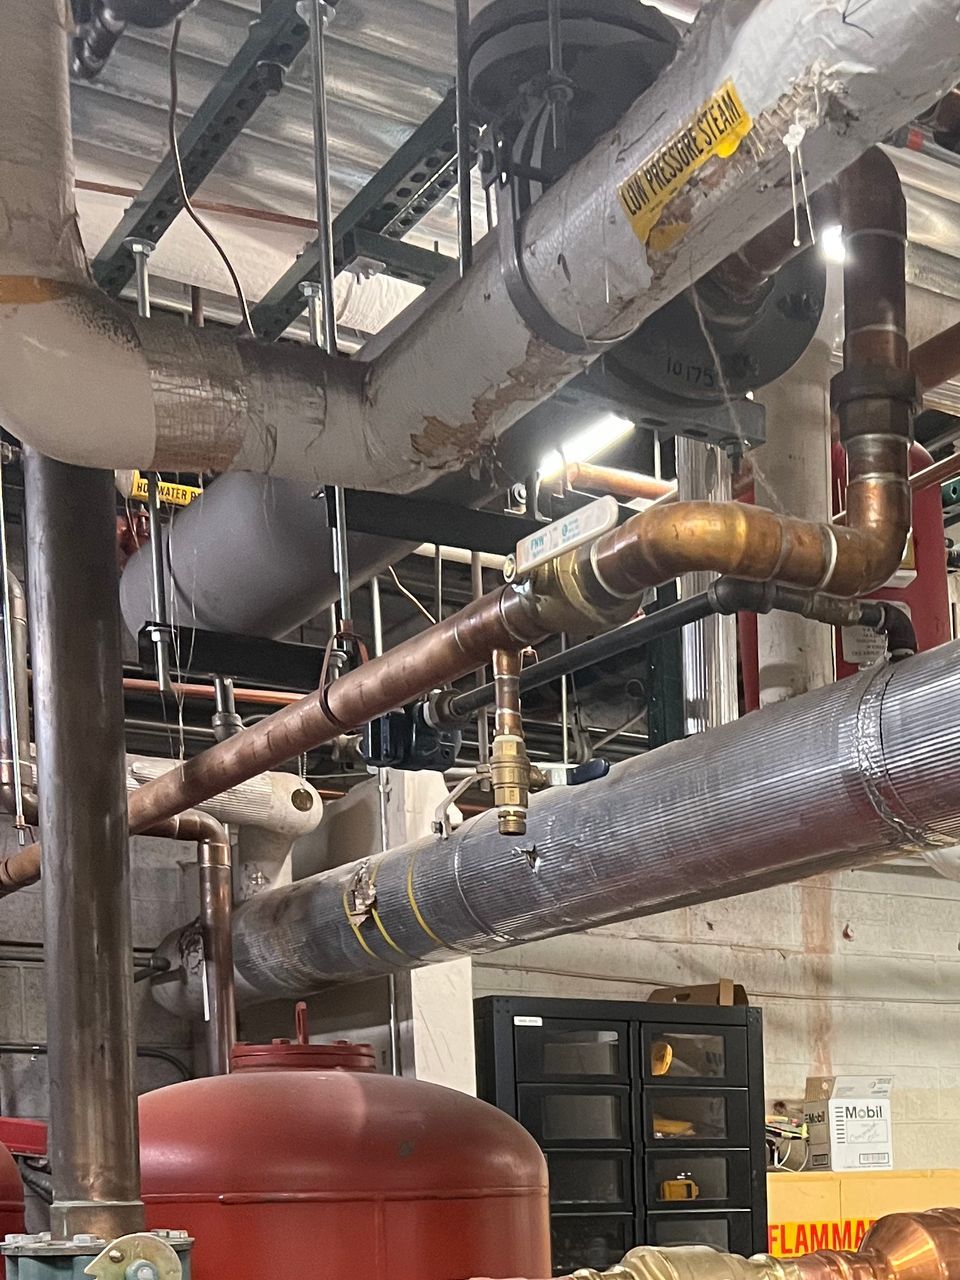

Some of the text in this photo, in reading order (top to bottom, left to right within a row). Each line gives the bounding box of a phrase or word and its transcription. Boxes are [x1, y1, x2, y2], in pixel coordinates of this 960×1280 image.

[620, 88, 742, 217] LOW PRESSURE STEAM
[136, 481, 149, 494] HO
[845, 1105, 883, 1119] Mobil
[768, 1219, 878, 1254] FLAMMA
